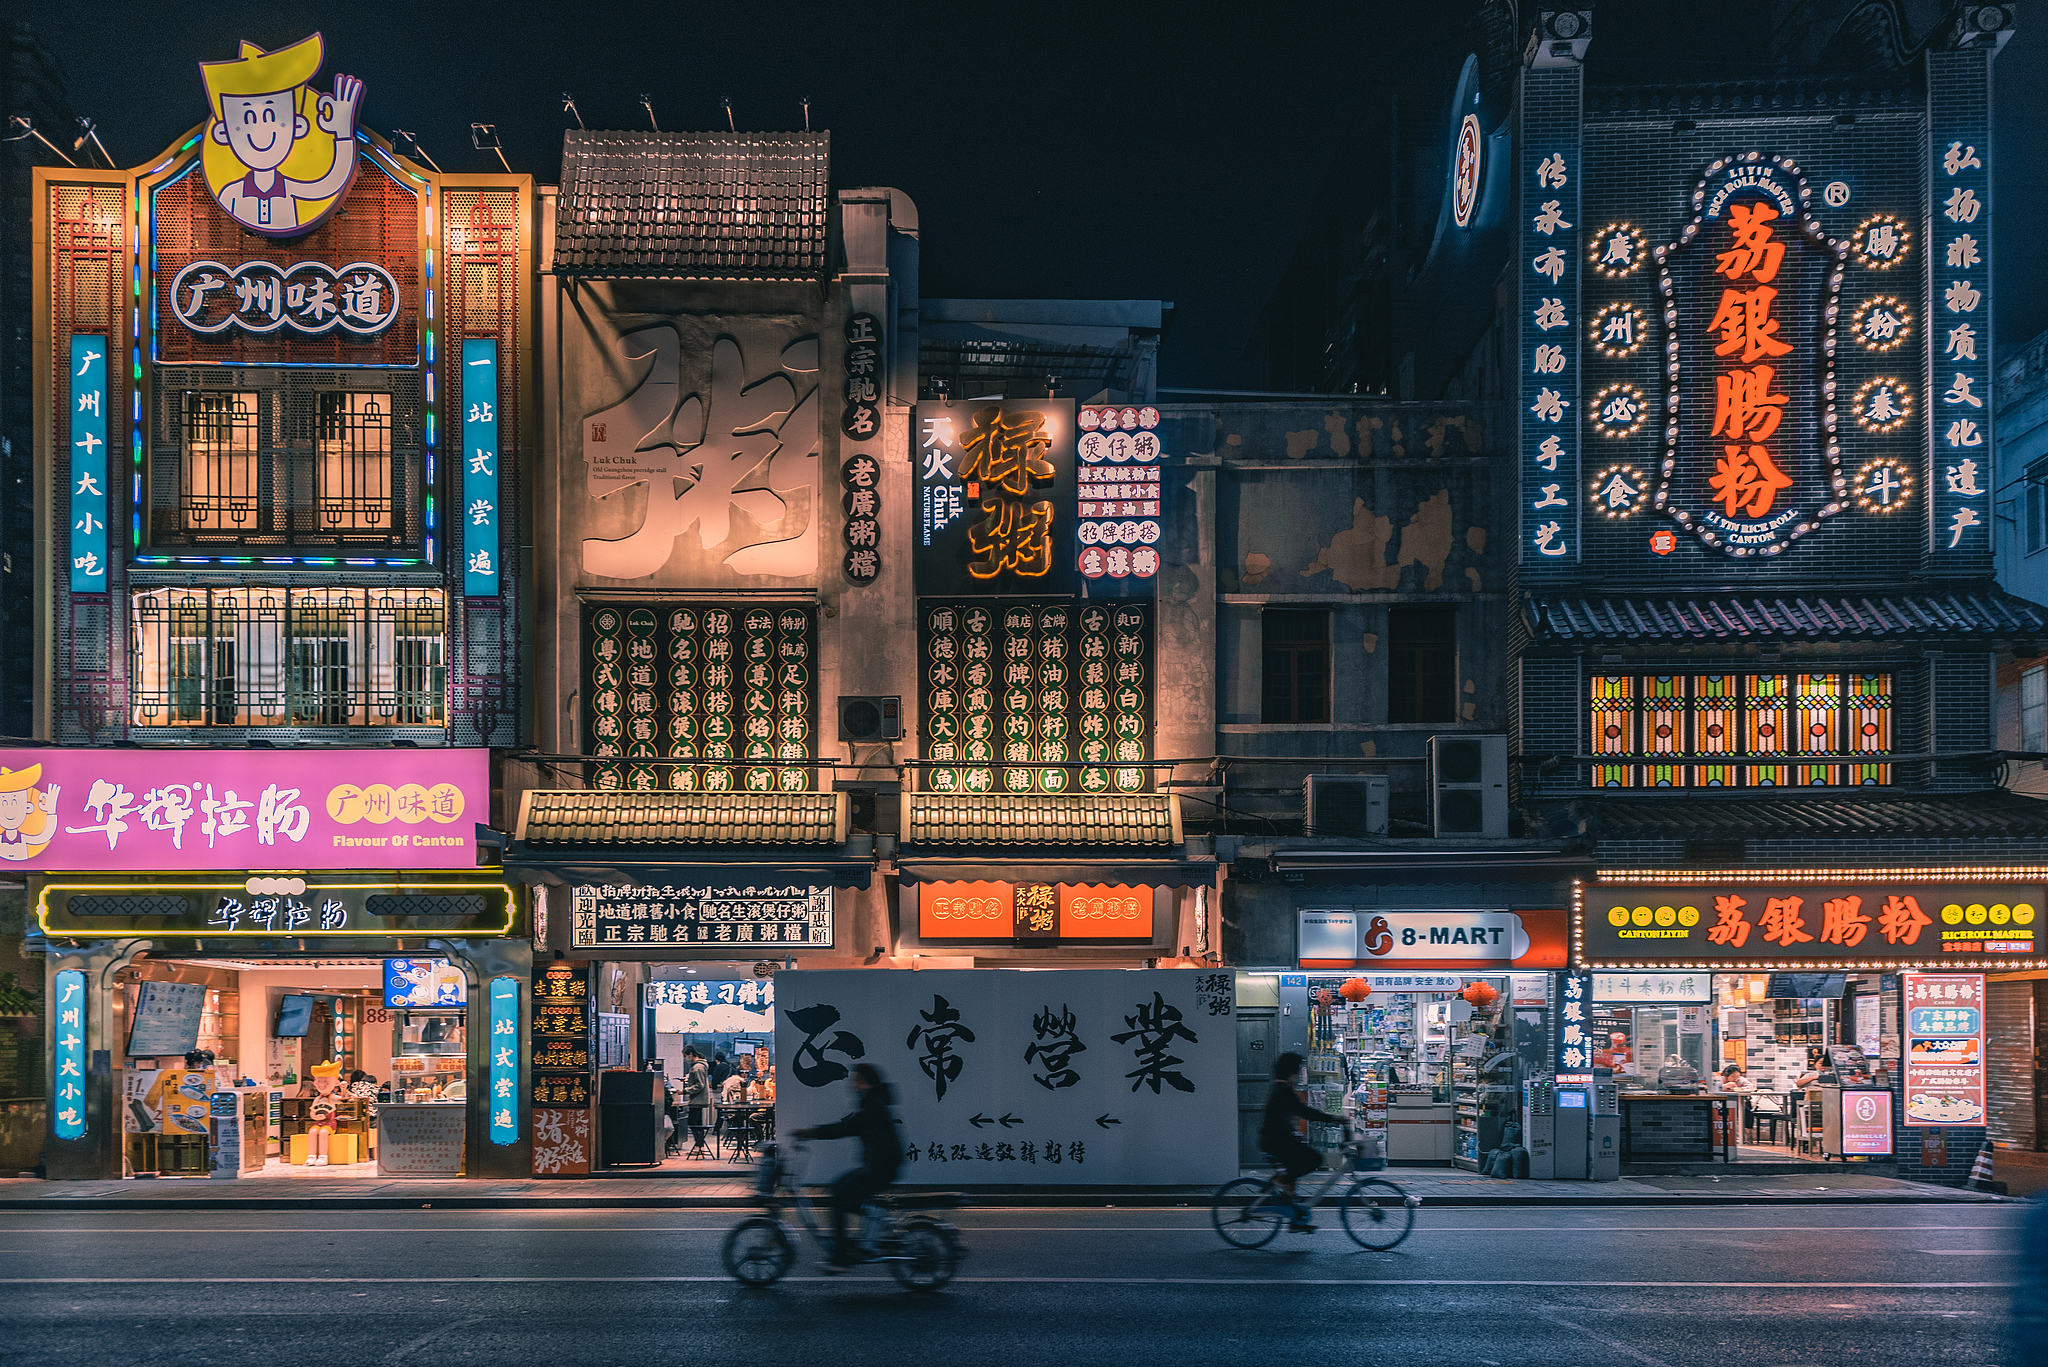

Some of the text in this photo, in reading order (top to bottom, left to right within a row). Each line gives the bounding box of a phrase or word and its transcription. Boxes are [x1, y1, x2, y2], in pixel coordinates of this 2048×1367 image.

[1725, 175, 1757, 193] ROLL
[1757, 177, 1795, 216] MASTER
[183, 274, 386, 323] 广州味道
[1531, 153, 1573, 557] 传承布拉肠粉手工艺
[1707, 202, 1794, 519] 荔銀腸粉
[1942, 141, 1985, 549] 弘扬非物质文化遗产
[848, 317, 877, 434] 正宗馳名
[1601, 232, 1637, 508] 廣州必食
[75, 351, 103, 576] 广州十大小吃
[468, 357, 495, 576] 一站式尝遍
[922, 417, 953, 480] 天火
[1084, 437, 1154, 458] 煲仔粥
[848, 458, 878, 578] 老廣粥檔
[923, 486, 931, 546] NATURE FLAME
[934, 485, 948, 530] Chuk
[949, 485, 963, 519] Luk
[1770, 509, 1799, 530] ROLL
[1082, 524, 1157, 541] 招牌拼搭
[1729, 531, 1776, 544] CANTON
[746, 616, 772, 630] 古法
[1040, 614, 1066, 628] 金牌
[1117, 613, 1141, 626] 爽口
[65, 778, 311, 850] 华辉拉肠
[337, 790, 460, 818] 广州味道
[333, 835, 464, 848] Flavour Of Canton
[207, 896, 348, 932] 华辉拉肠
[603, 924, 690, 941] 正宗馳名
[714, 924, 803, 941] 老廣粥檔
[1707, 894, 1933, 949] 荔銀腸粉
[1401, 927, 1504, 945] 8-MART
[1286, 977, 1302, 985] 142
[1375, 977, 1455, 986] 国有品牌 安全 放心
[59, 983, 82, 1126] 广州十大小吃
[493, 994, 515, 1131] 一站式尝遍
[784, 991, 1198, 1102] 正常營業
[905, 1140, 1086, 1164] 升級改造敬請期待
[1923, 1140, 1940, 1148] TOP
